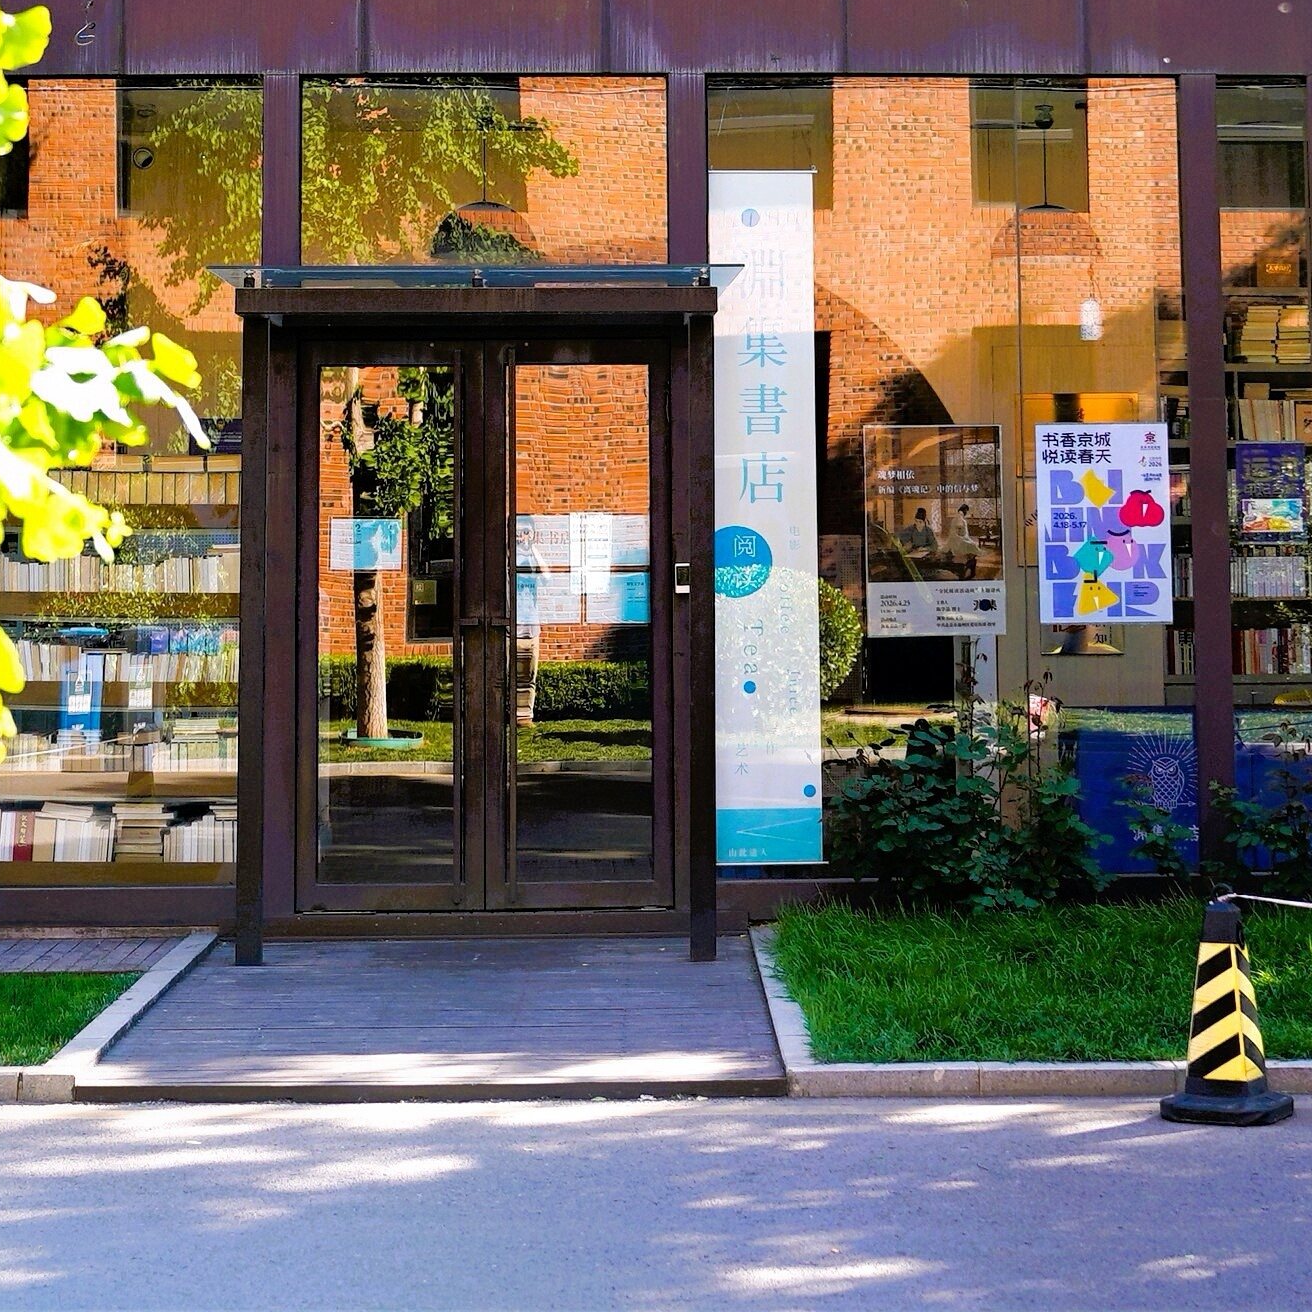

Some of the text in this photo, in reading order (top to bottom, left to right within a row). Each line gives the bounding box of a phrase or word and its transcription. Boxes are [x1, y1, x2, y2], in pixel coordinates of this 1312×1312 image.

[1042, 432, 1111, 447] 书香京城
[1042, 449, 1112, 464] 悦读春天
[1053, 512, 1077, 520] 2026.
[743, 618, 764, 675] Tea
